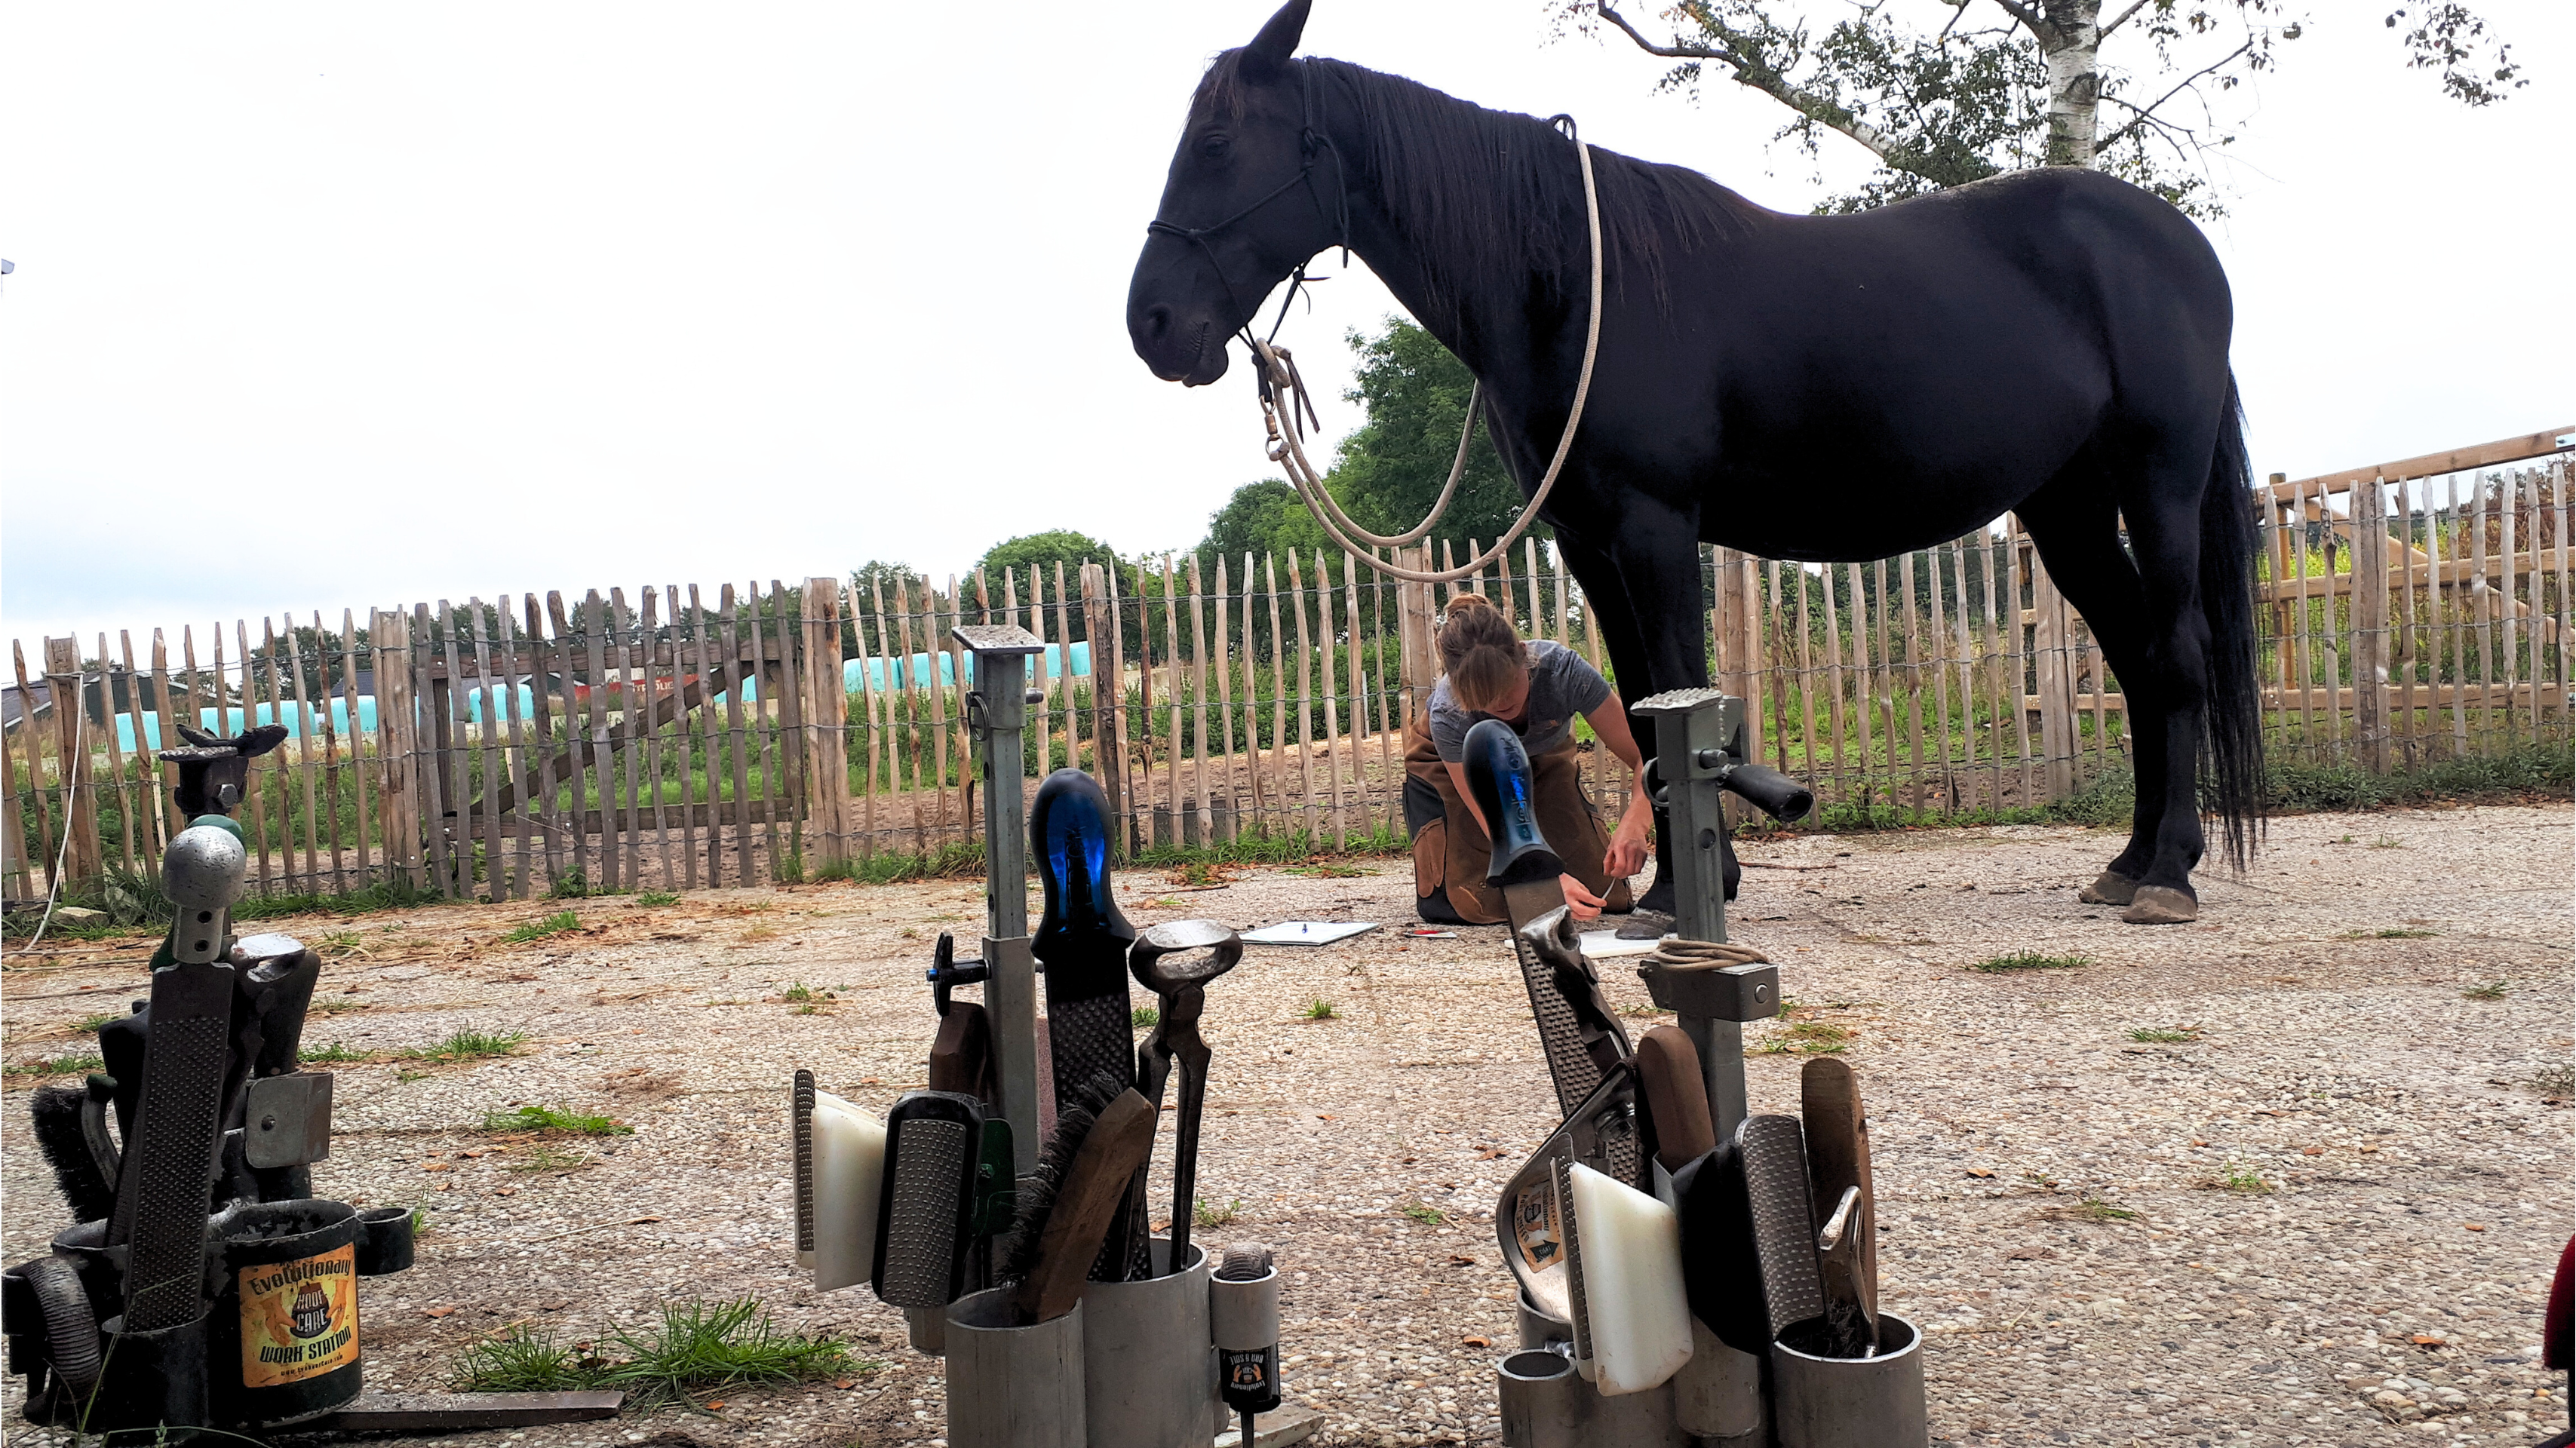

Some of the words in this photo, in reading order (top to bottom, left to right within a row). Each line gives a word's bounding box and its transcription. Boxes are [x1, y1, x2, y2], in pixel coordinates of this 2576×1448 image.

[250, 1259, 351, 1296] Evolutionary
[296, 1289, 324, 1309] HOOF
[296, 1308, 327, 1333] CARE
[259, 1345, 303, 1364] WORK
[308, 1326, 352, 1360] STATION
[1251, 1354, 1263, 1363] BAR
[1230, 1380, 1265, 1391] Evolutionary
